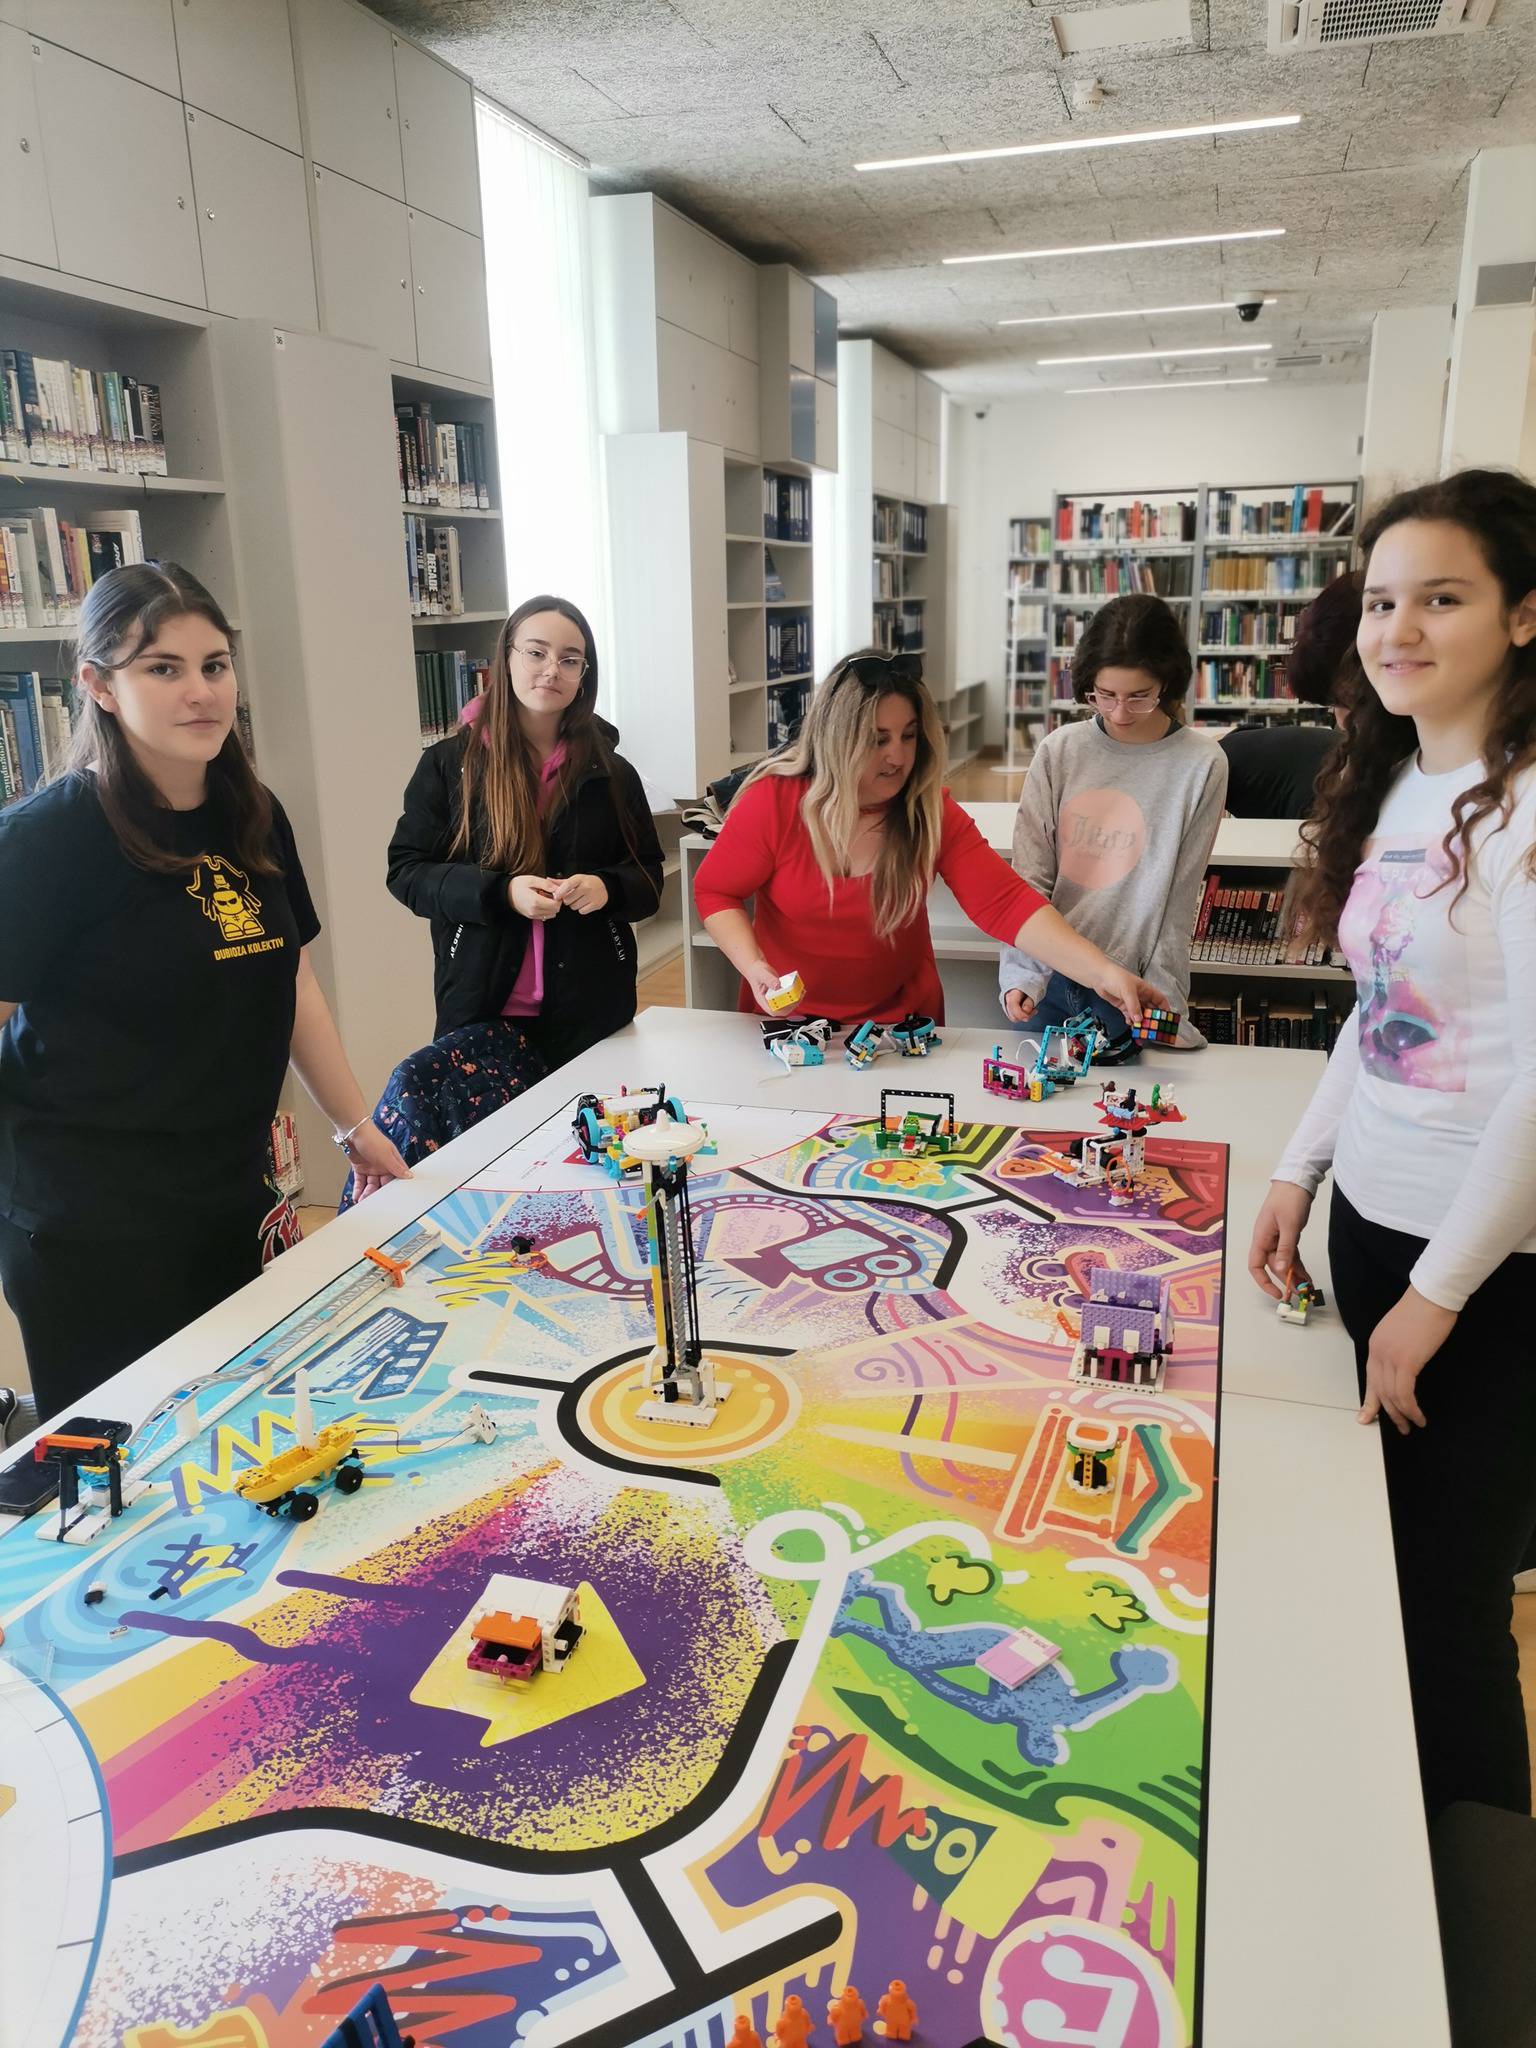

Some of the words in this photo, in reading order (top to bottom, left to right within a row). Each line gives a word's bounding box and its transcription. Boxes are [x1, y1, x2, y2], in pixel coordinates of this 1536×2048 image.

[426, 553, 438, 592] DECADE
[213, 944, 248, 961] DUBIOZA
[247, 937, 284, 954] KOLEKTIV
